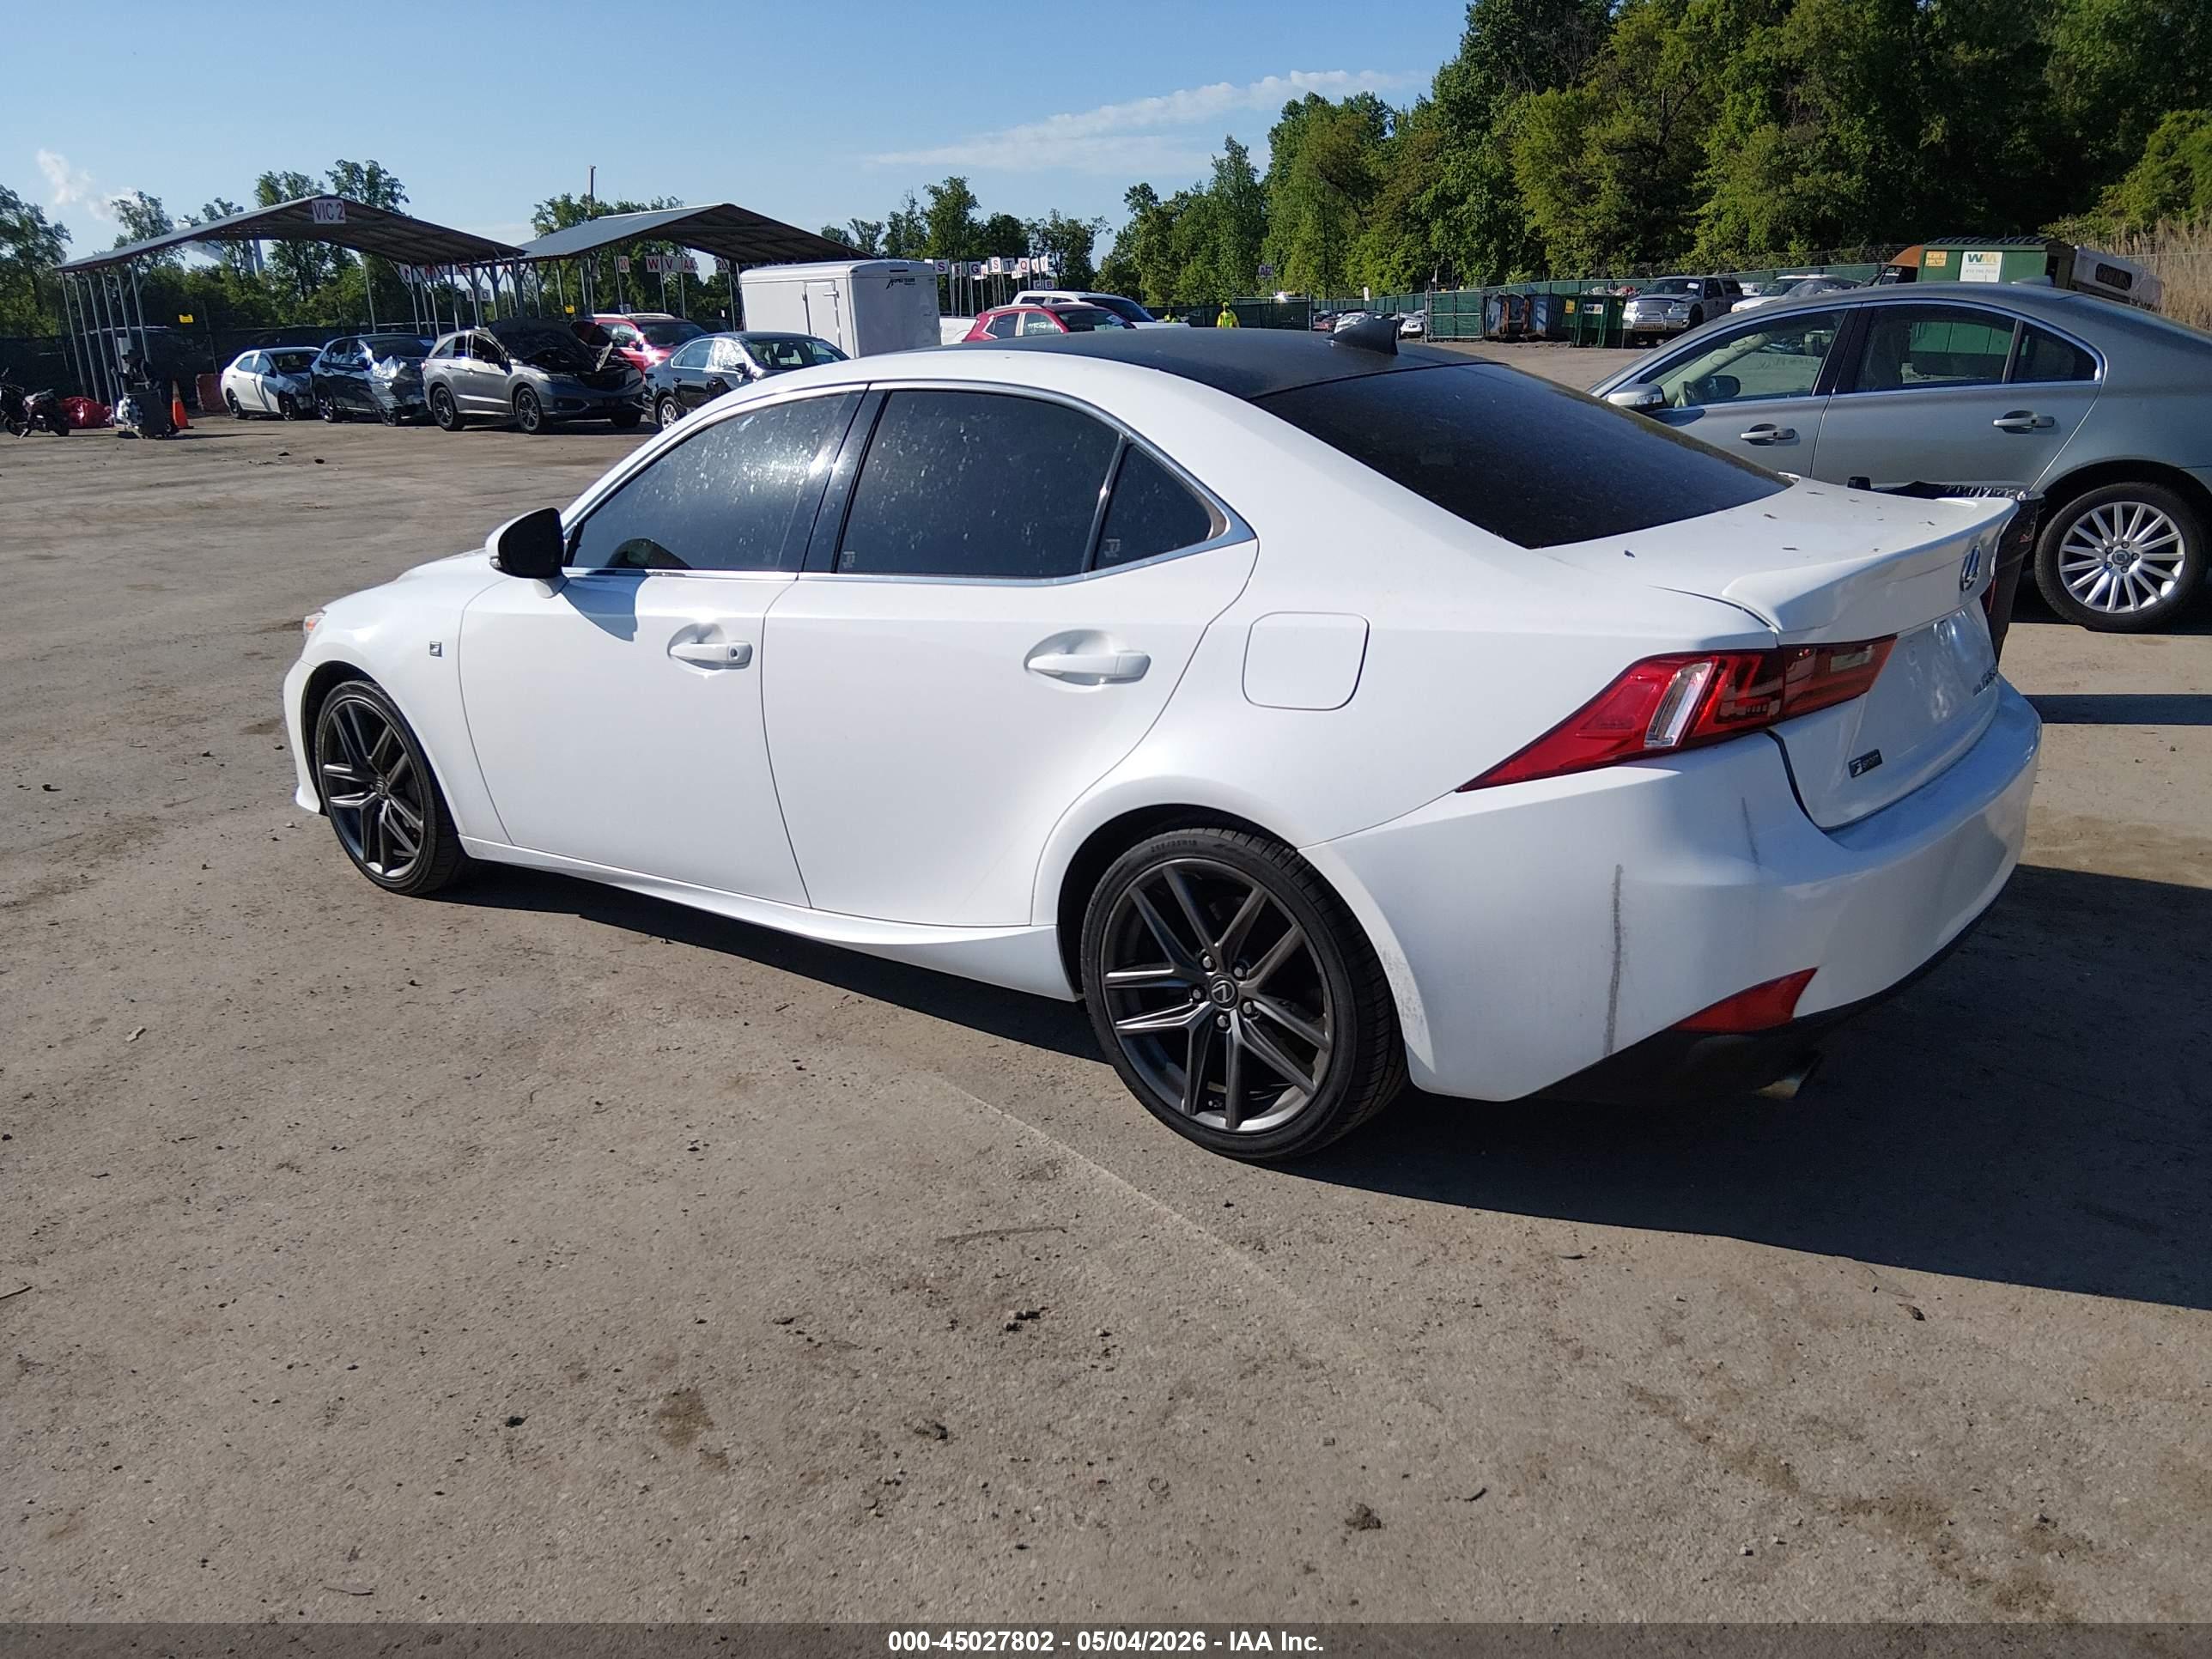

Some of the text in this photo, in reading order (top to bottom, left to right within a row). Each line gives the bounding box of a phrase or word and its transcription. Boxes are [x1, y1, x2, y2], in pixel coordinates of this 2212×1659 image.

[313, 203, 344, 220] VIC 2
[647, 259, 659, 270] W
[665, 259, 673, 270] V
[938, 261, 945, 271] S
[971, 264, 979, 274] G
[994, 259, 999, 270] S
[1005, 260, 1012, 270] T
[1020, 260, 1028, 270] Q
